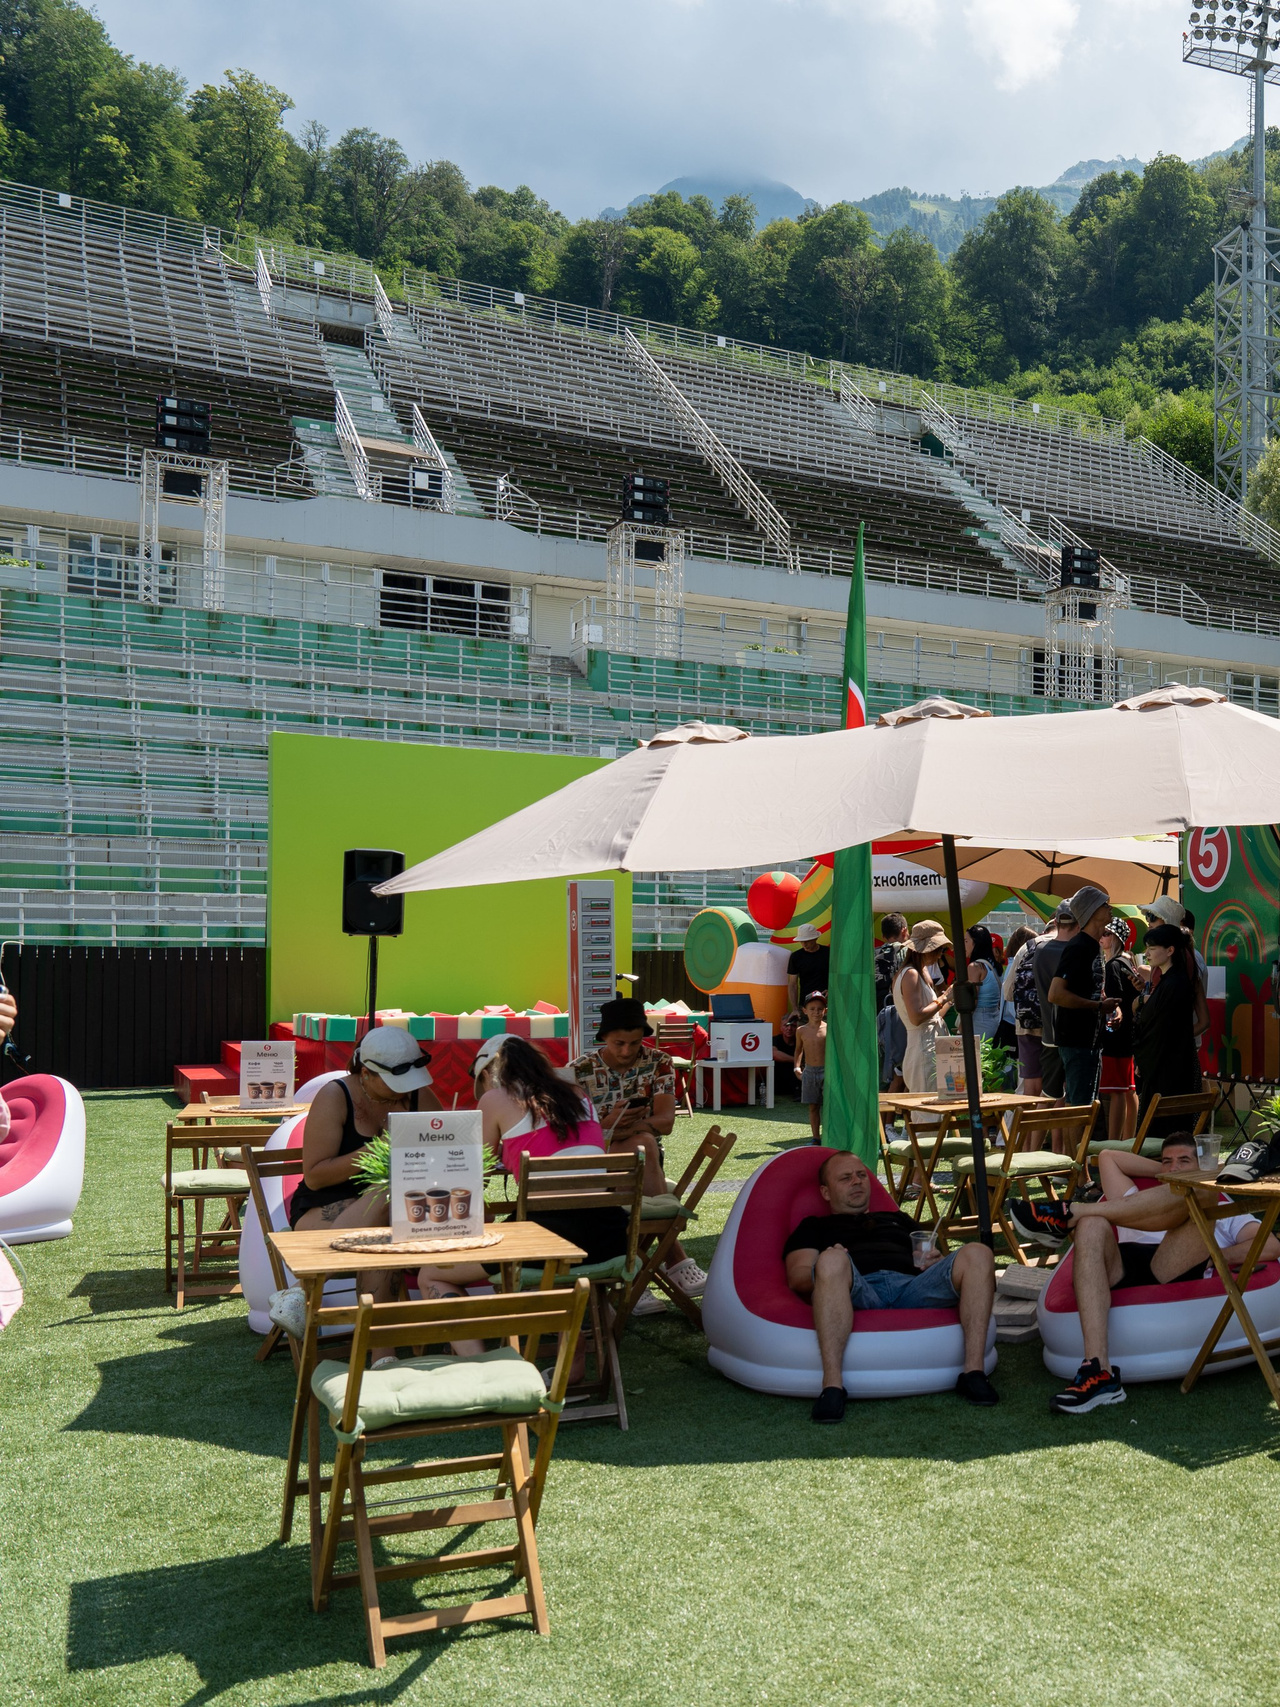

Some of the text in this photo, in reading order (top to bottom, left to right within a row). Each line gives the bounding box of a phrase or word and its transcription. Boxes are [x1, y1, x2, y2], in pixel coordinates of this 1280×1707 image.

[1198, 827, 1219, 878] 5
[870, 871, 942, 888] хновляет
[744, 1034, 757, 1050] 5
[418, 1132, 455, 1142] Меню
[404, 1151, 426, 1159] Кофе
[411, 1224, 467, 1234] Время пробовать
